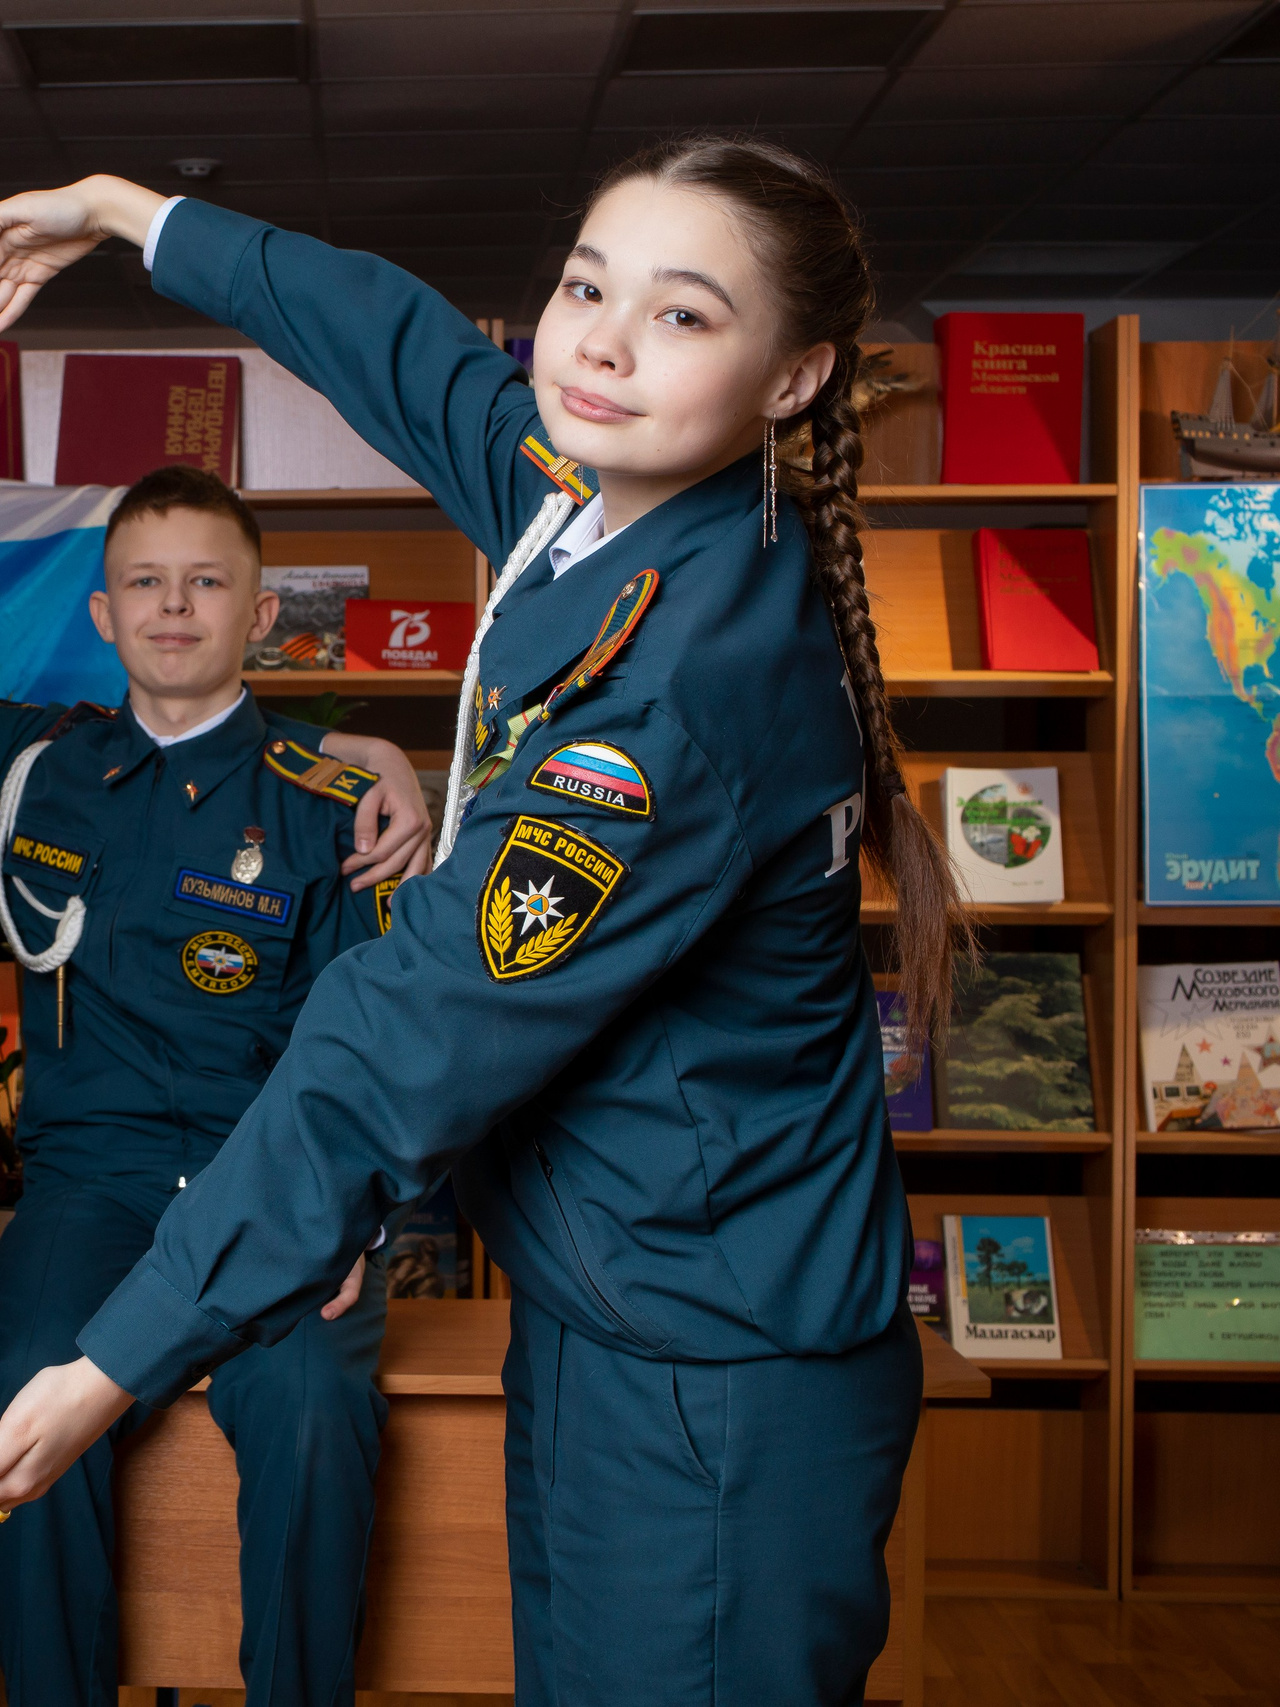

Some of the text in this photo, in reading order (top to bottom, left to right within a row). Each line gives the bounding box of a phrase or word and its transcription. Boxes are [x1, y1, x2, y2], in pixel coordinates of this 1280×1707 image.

[971, 359, 1028, 370] книга
[973, 340, 1057, 358] Красная
[969, 382, 1028, 395] области
[971, 370, 1060, 383] Московской
[164, 385, 187, 455] КОННАЯ
[184, 388, 207, 454] ПЕРВАЯ
[202, 362, 228, 476] ЛЕГЕНДАРНА
[388, 609, 432, 648] 75
[381, 648, 438, 662] ПОБЕДА!
[334, 774, 360, 791] К
[553, 774, 626, 807] RUSSIA
[12, 835, 84, 874] МЧС РОССИИ
[517, 823, 616, 884] МЧС РОССИИ
[180, 875, 283, 917] КУЗЬМИНОВ М.Н.
[189, 934, 254, 965] МЧС РОССИИ
[186, 959, 250, 990] EMERCOM
[965, 1325, 1056, 1343] Мадагаскар
